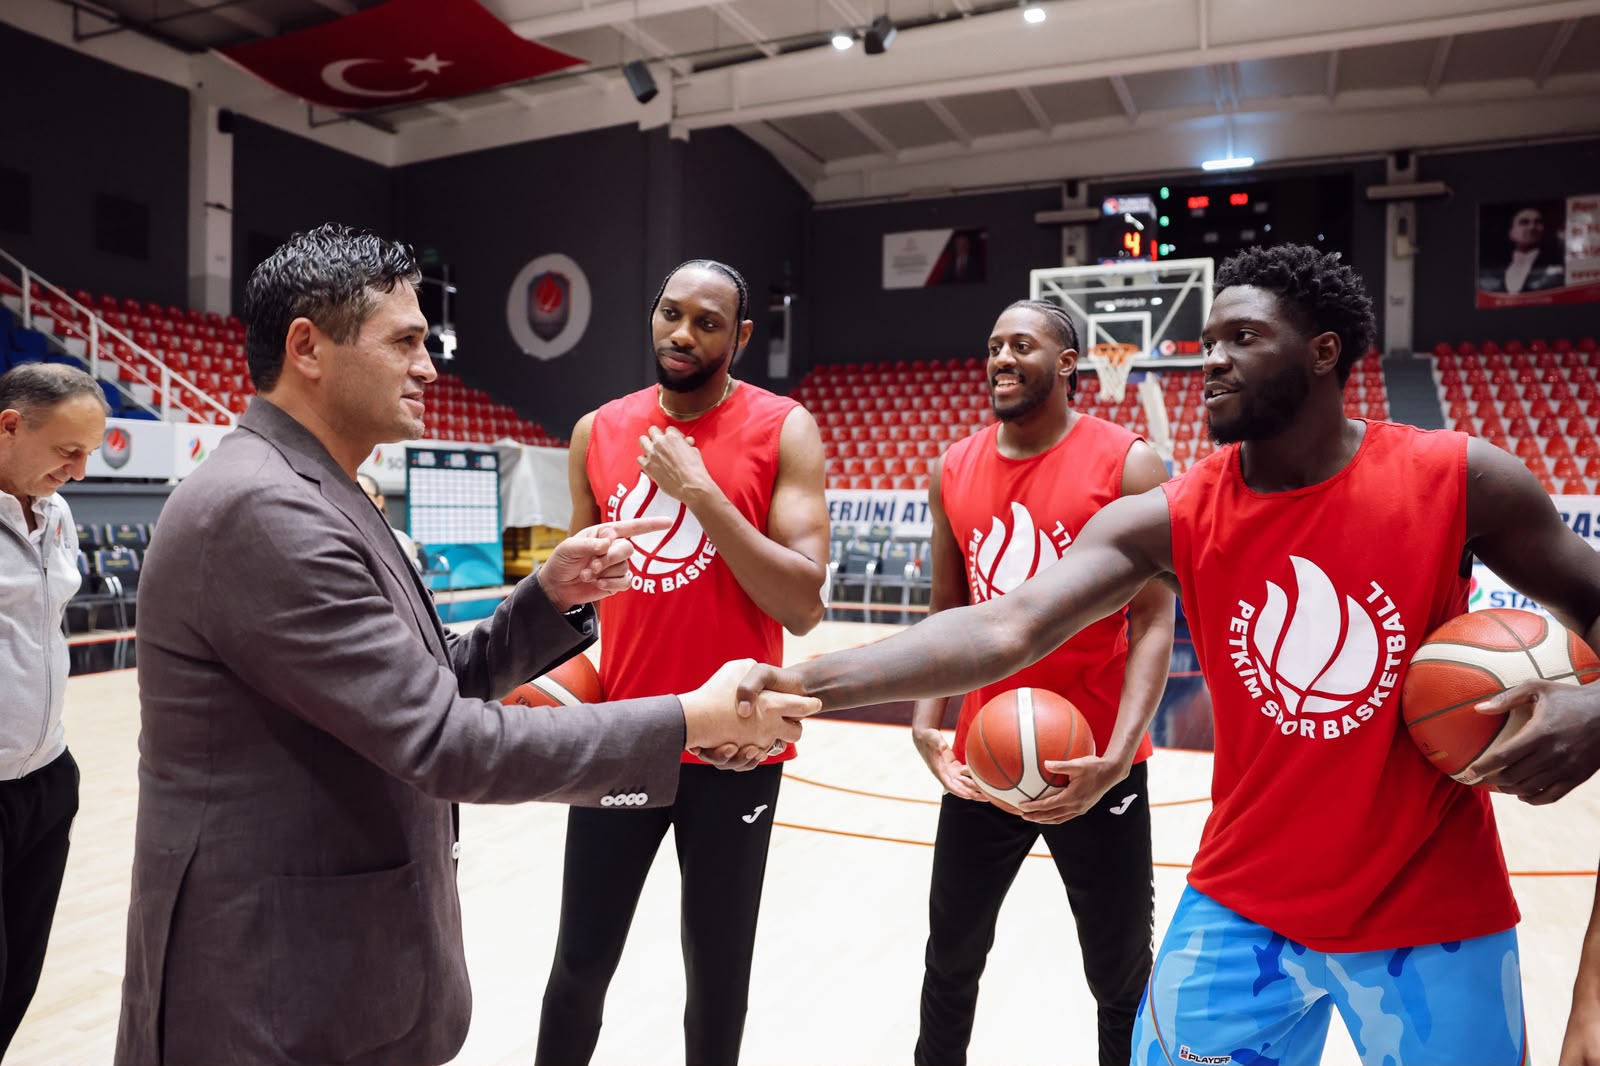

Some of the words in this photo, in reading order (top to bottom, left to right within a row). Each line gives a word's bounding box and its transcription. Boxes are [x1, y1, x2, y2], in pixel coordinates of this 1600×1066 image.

[1124, 231, 1141, 257] 4
[1490, 591, 1544, 609] STA
[1261, 700, 1315, 739] SPOR
[1323, 581, 1406, 739] BASKETBALL
[1188, 1053, 1231, 1065] PLAYOFF
